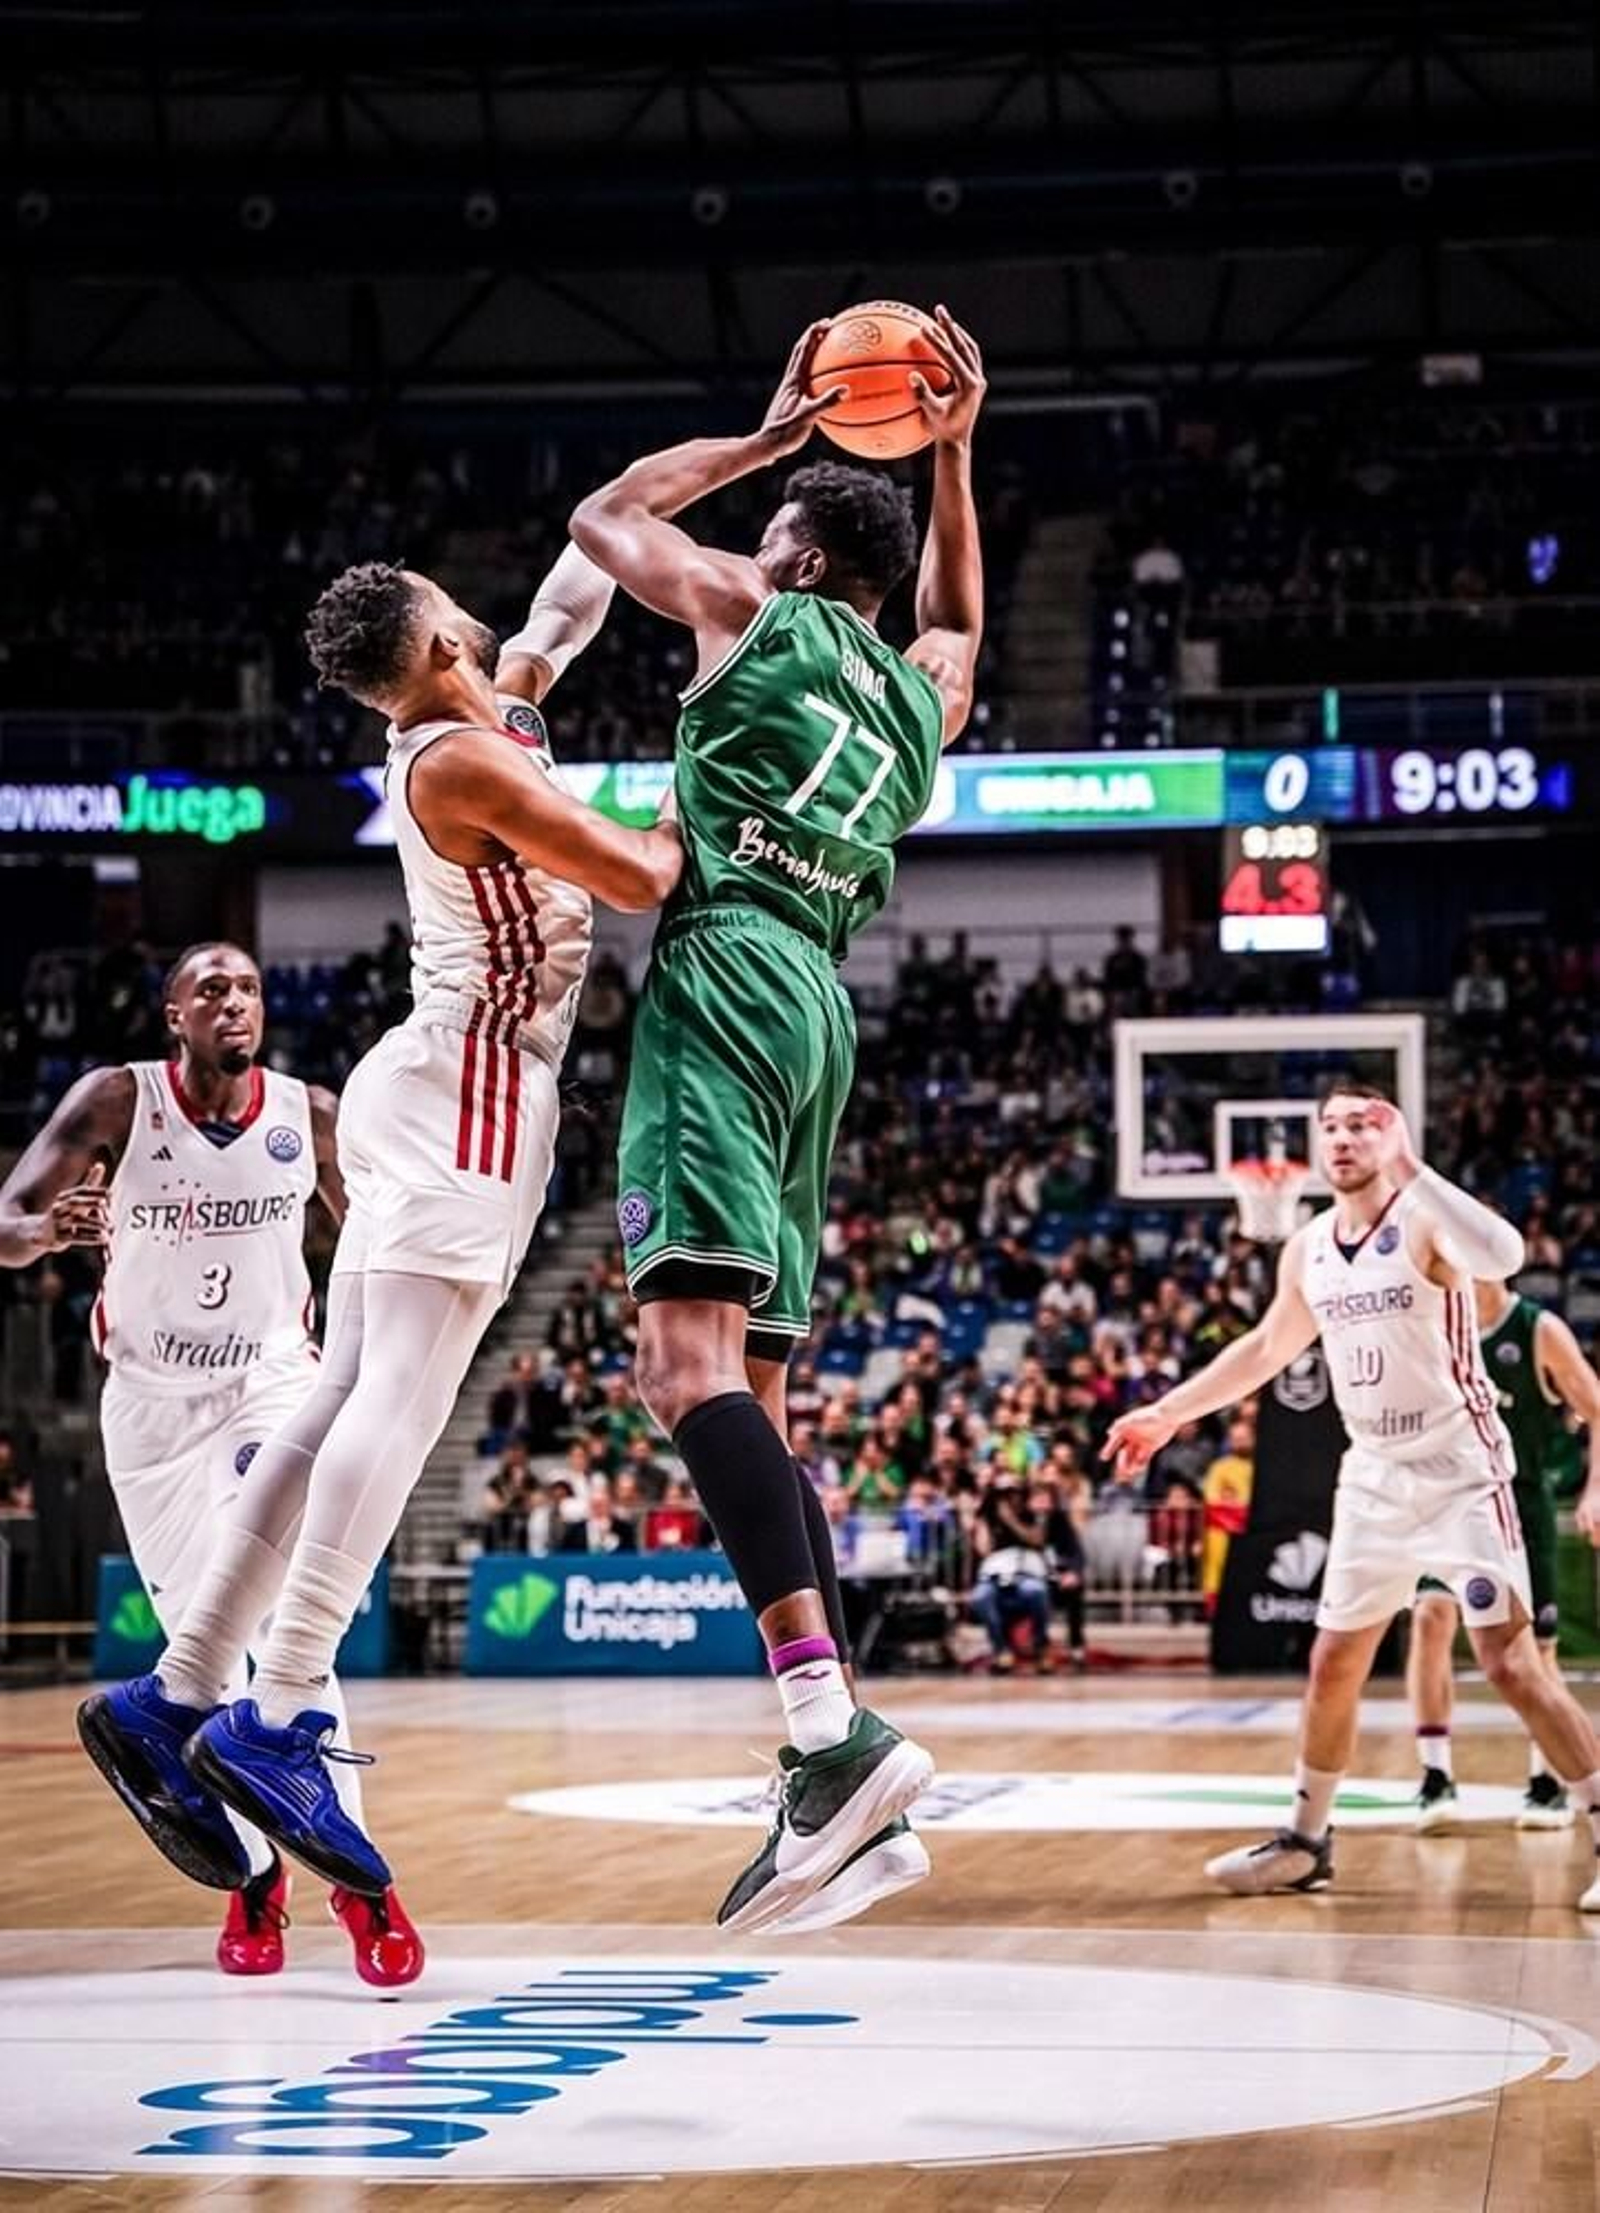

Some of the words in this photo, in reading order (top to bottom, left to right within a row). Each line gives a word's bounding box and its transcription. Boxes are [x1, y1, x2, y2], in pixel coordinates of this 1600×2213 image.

[840, 650, 887, 708] SIMA
[782, 692, 898, 840] 77
[1264, 753, 1309, 812] 0
[1391, 747, 1539, 814] 9:03
[122, 774, 265, 843] Juega
[1222, 862, 1322, 914] 4.3
[130, 1193, 297, 1246] STRASBOURG
[196, 1260, 232, 1311] 3
[1349, 1345, 1384, 1388] 10
[563, 1610, 697, 1650] Unicaja
